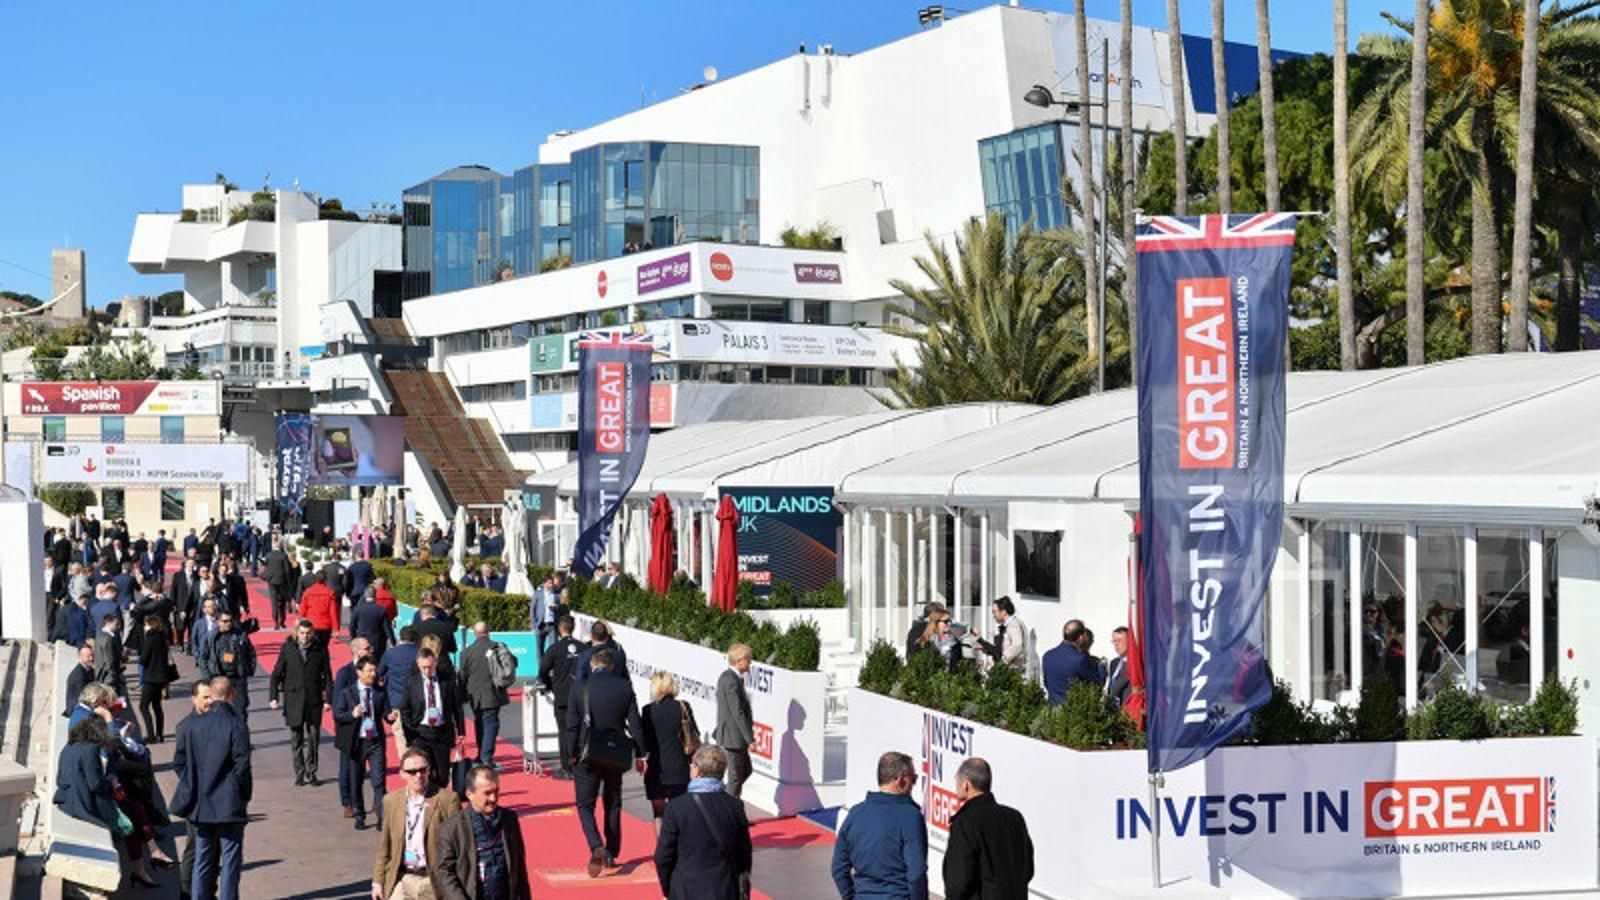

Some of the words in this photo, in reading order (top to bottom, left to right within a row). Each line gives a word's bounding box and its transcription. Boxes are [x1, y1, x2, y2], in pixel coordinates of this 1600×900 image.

[1237, 276, 1249, 331] IRELAND
[723, 334, 761, 350] PALAIS
[761, 336, 769, 351] 3
[1184, 286, 1228, 461] GREAT
[1239, 336, 1249, 405] NORTHERN
[62, 386, 121, 403] Spanish
[81, 403, 121, 413] pavilion
[600, 366, 622, 449] GREAT
[1239, 407, 1249, 417] &
[1237, 420, 1249, 469] BRITAIN
[106, 458, 135, 466] RIVIERA
[106, 470, 135, 478] RIVIERA
[600, 459, 620, 482] IN
[733, 495, 831, 513] MIDLANDS
[1188, 485, 1226, 533] IN
[1184, 549, 1226, 723] INVEST
[931, 715, 975, 758] INVEST
[931, 750, 943, 783] IN
[1116, 793, 1287, 840] INVEST
[1303, 790, 1349, 834] IN
[1370, 784, 1535, 832] GREAT
[1364, 844, 1411, 857] BRITAIN
[1413, 844, 1421, 854] &
[1424, 841, 1487, 854] NORTHERN
[1491, 839, 1542, 852] IRELAND
